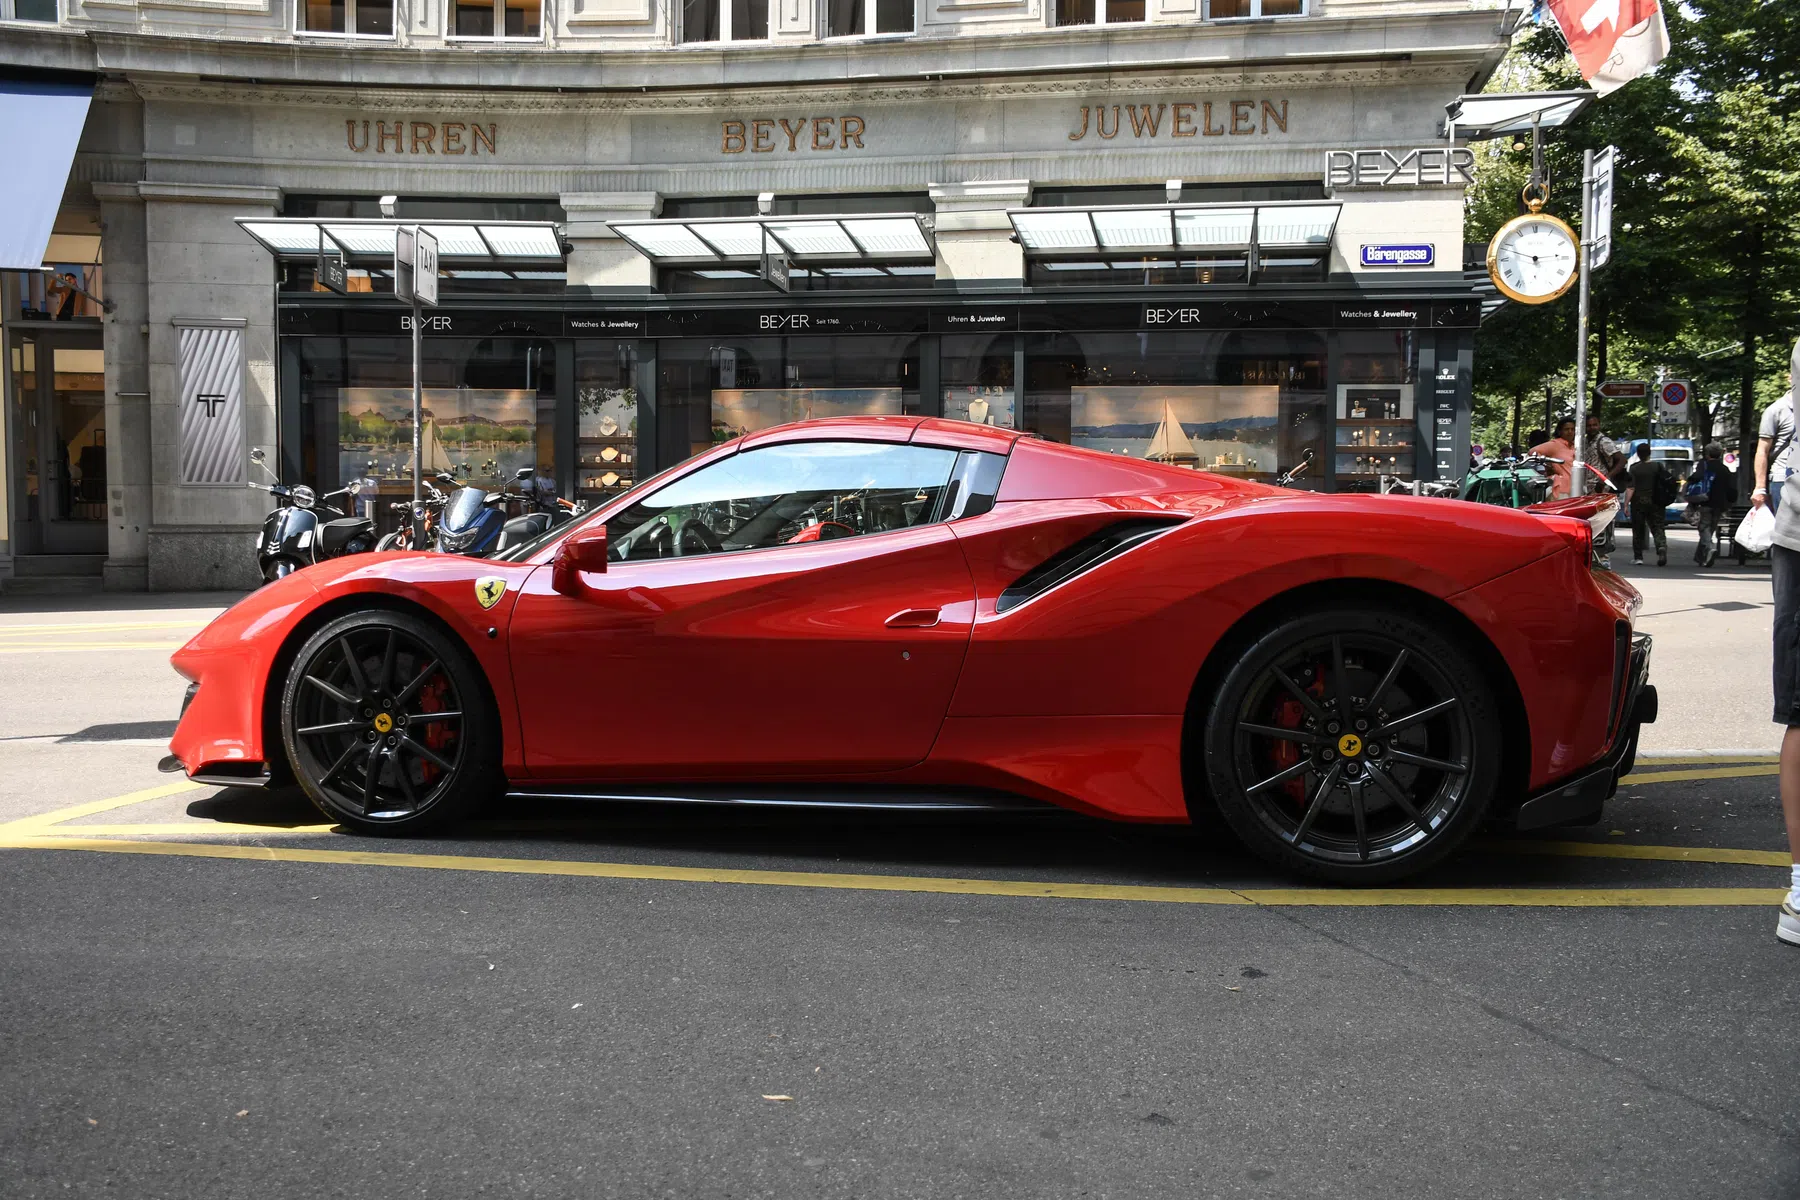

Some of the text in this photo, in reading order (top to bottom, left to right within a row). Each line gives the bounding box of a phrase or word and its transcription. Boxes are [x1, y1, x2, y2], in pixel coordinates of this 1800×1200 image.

[1068, 100, 1289, 141] JUWELEN
[346, 119, 497, 155] UHREN
[721, 115, 866, 153] BEYER
[1324, 147, 1476, 188] BEYER
[420, 244, 436, 276] TAXI
[1366, 246, 1428, 264] Bärengasse
[760, 314, 810, 329] BEYER
[947, 314, 1006, 323] Uhren & Juwelen
[1146, 308, 1201, 323] BEYER
[1340, 309, 1418, 319] Watches & Jewellery
[571, 320, 639, 330] Watches & Jewellery
